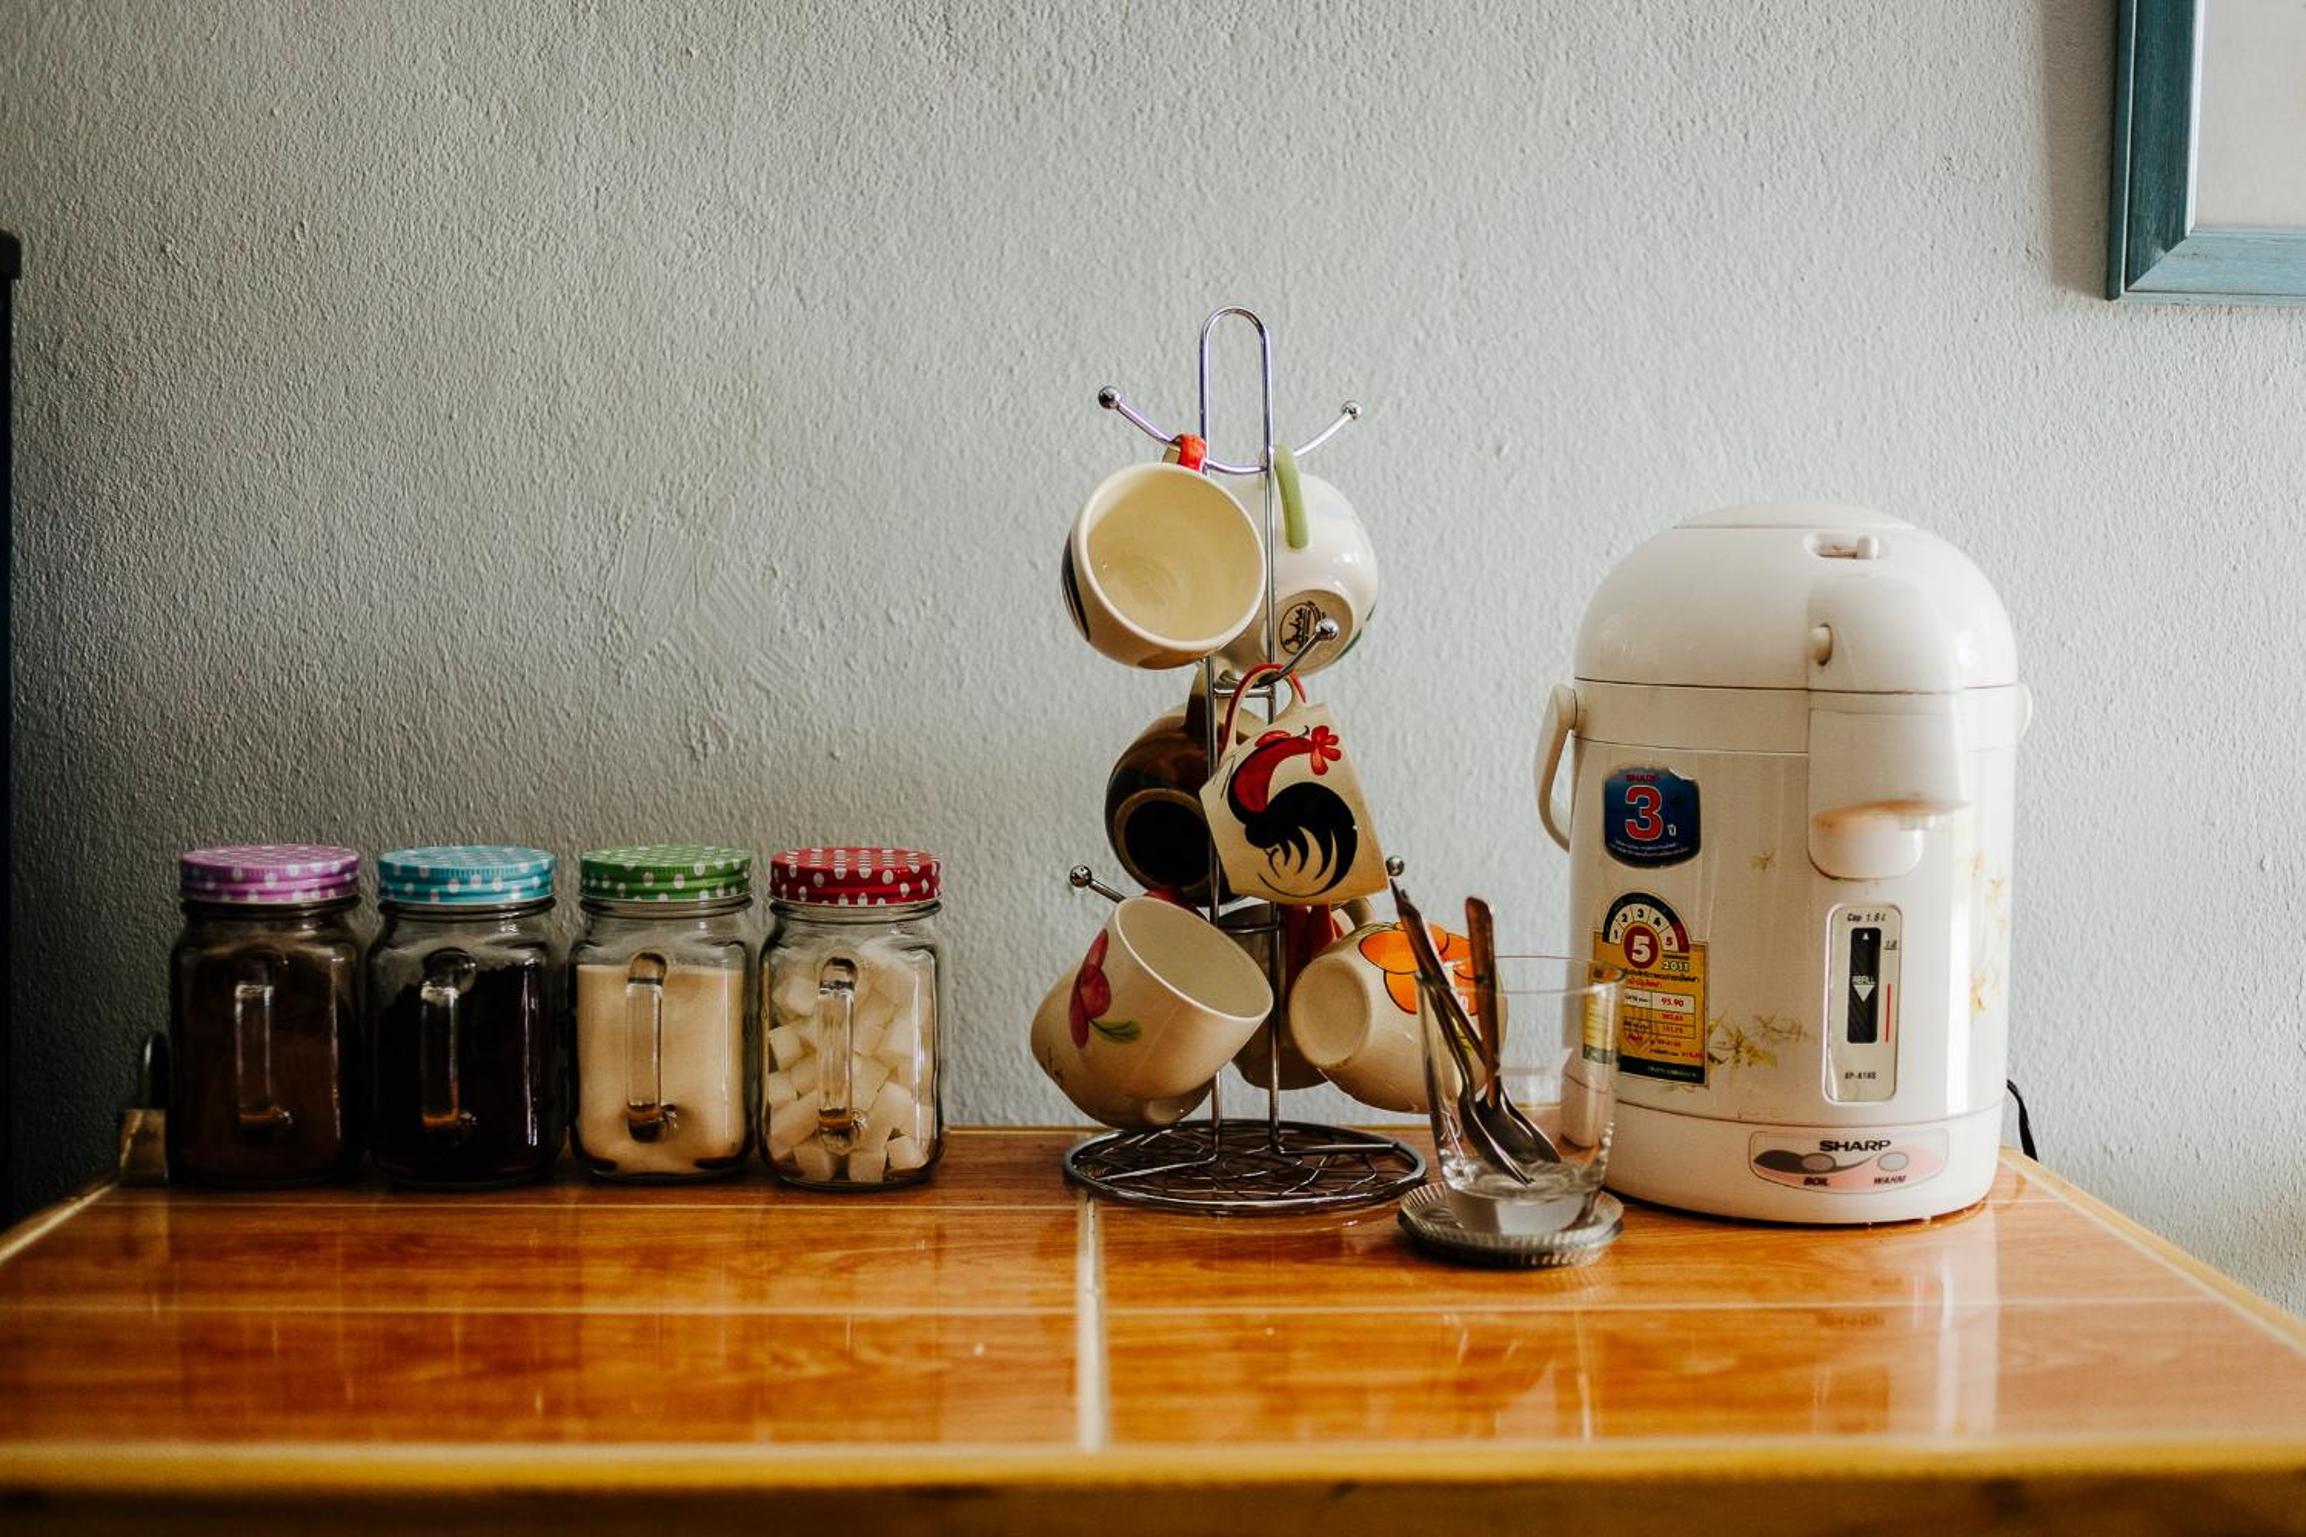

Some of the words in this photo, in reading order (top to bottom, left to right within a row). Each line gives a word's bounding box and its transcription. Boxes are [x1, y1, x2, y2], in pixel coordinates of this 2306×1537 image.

[1625, 785, 1664, 841] 3
[1613, 930, 1619, 940] 1
[1622, 912, 1629, 923] 2
[1636, 908, 1644, 919] 3
[1653, 916, 1661, 928] 4
[1666, 937, 1674, 946] 5
[1631, 935, 1651, 963] 5
[1819, 1139, 1892, 1152] SHARP
